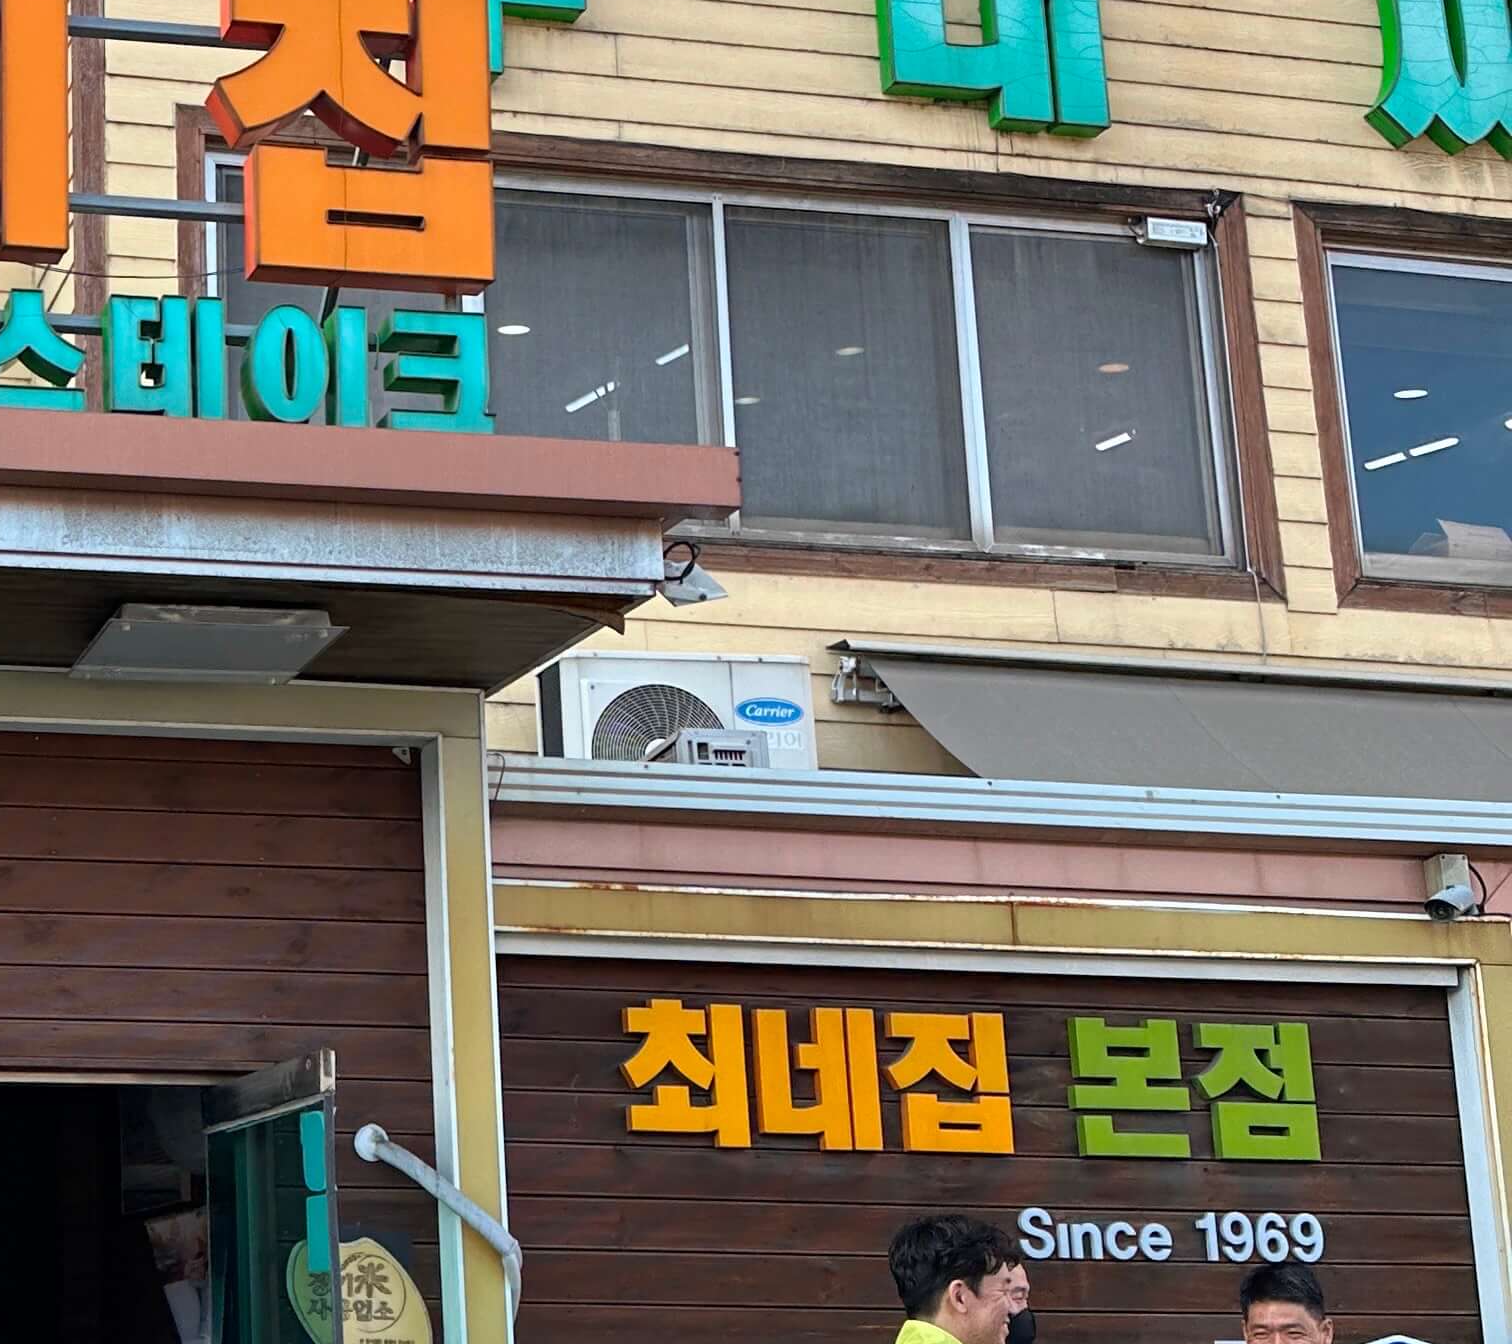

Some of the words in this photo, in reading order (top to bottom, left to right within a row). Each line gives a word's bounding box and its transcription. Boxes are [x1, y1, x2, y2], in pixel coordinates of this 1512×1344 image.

[745, 703, 795, 718] Carrier
[621, 999, 1015, 1154] 최네집
[1068, 1016, 1322, 1161] 본점
[1018, 1207, 1174, 1262] Since
[1194, 1211, 1325, 1264] 1969
